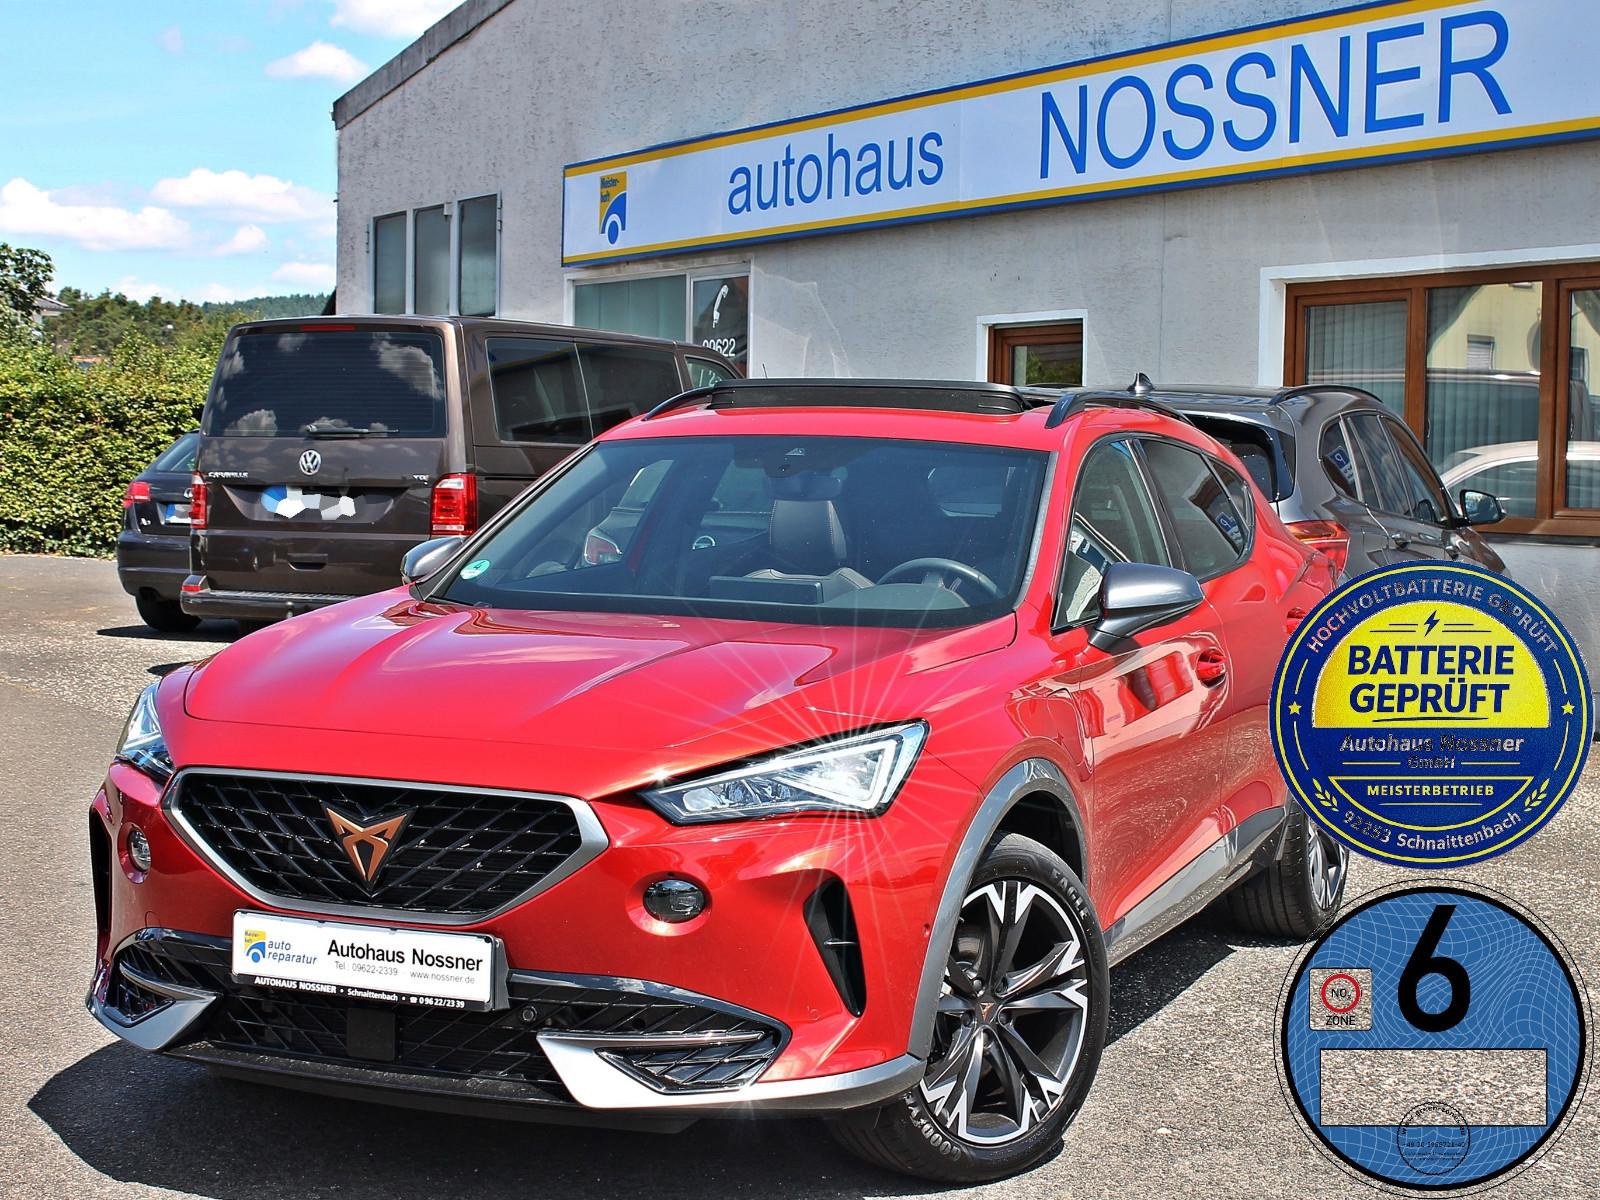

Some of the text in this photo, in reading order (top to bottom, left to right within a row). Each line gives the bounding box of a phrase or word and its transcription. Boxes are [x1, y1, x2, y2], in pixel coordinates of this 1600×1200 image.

[728, 10, 1512, 216] autohaus NOSSNER
[267, 951, 318, 965] reparatur
[268, 940, 292, 951] auto
[327, 939, 483, 971] Autohaus Nossner
[254, 976, 298, 989] AUTOHAUS
[299, 981, 337, 994] NOSSNER
[347, 988, 398, 1001] Schnaittenbach
